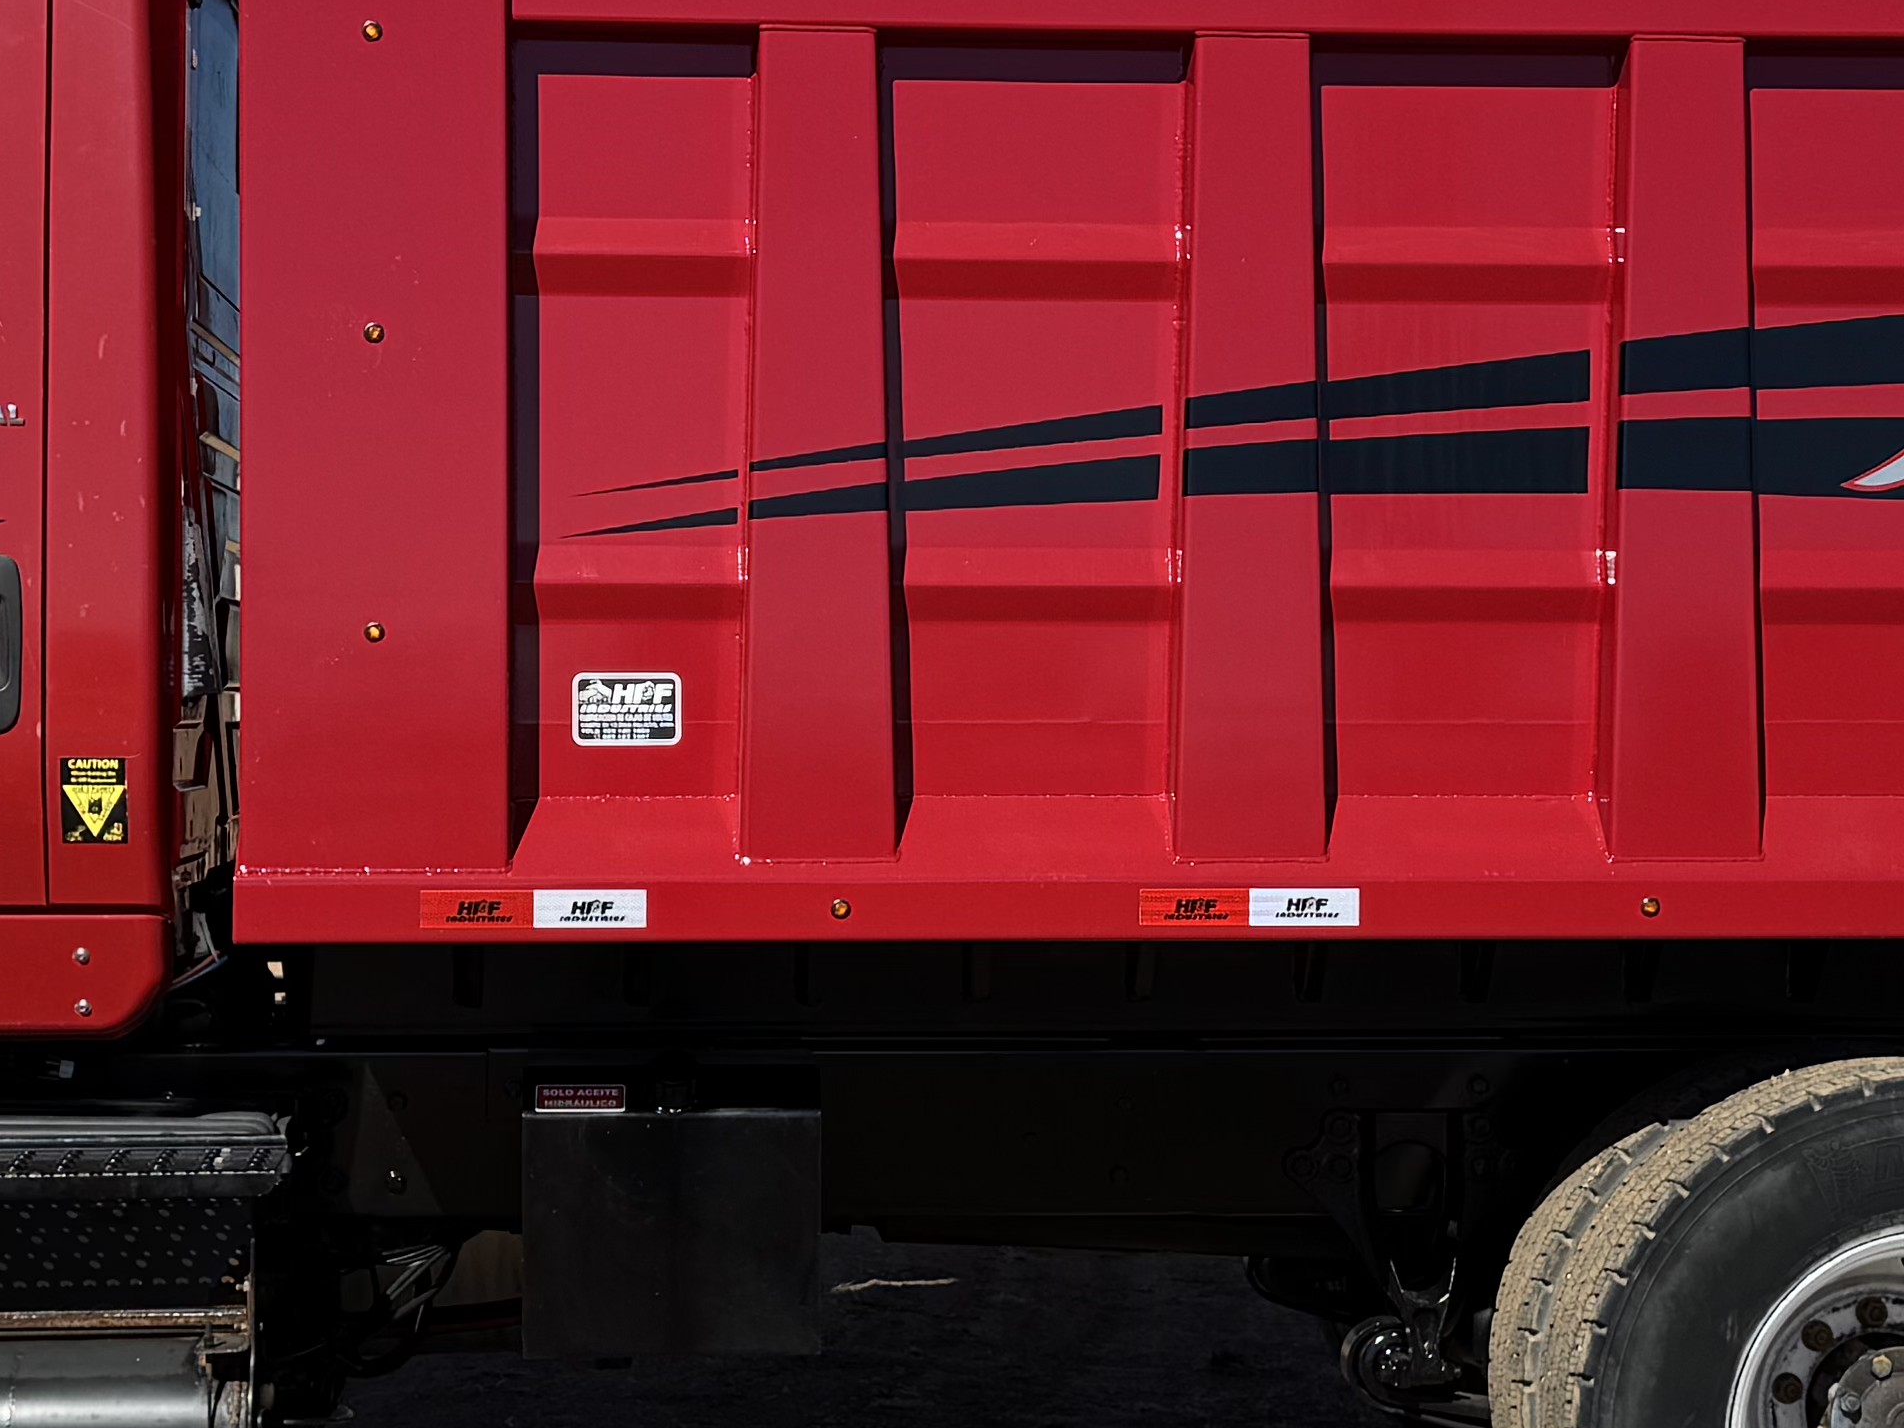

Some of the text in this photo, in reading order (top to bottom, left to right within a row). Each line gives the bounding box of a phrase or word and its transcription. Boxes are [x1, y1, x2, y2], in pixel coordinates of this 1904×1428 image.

[67, 759, 119, 770] CAUTION
[542, 1088, 619, 1097] SOLO ACEITE
